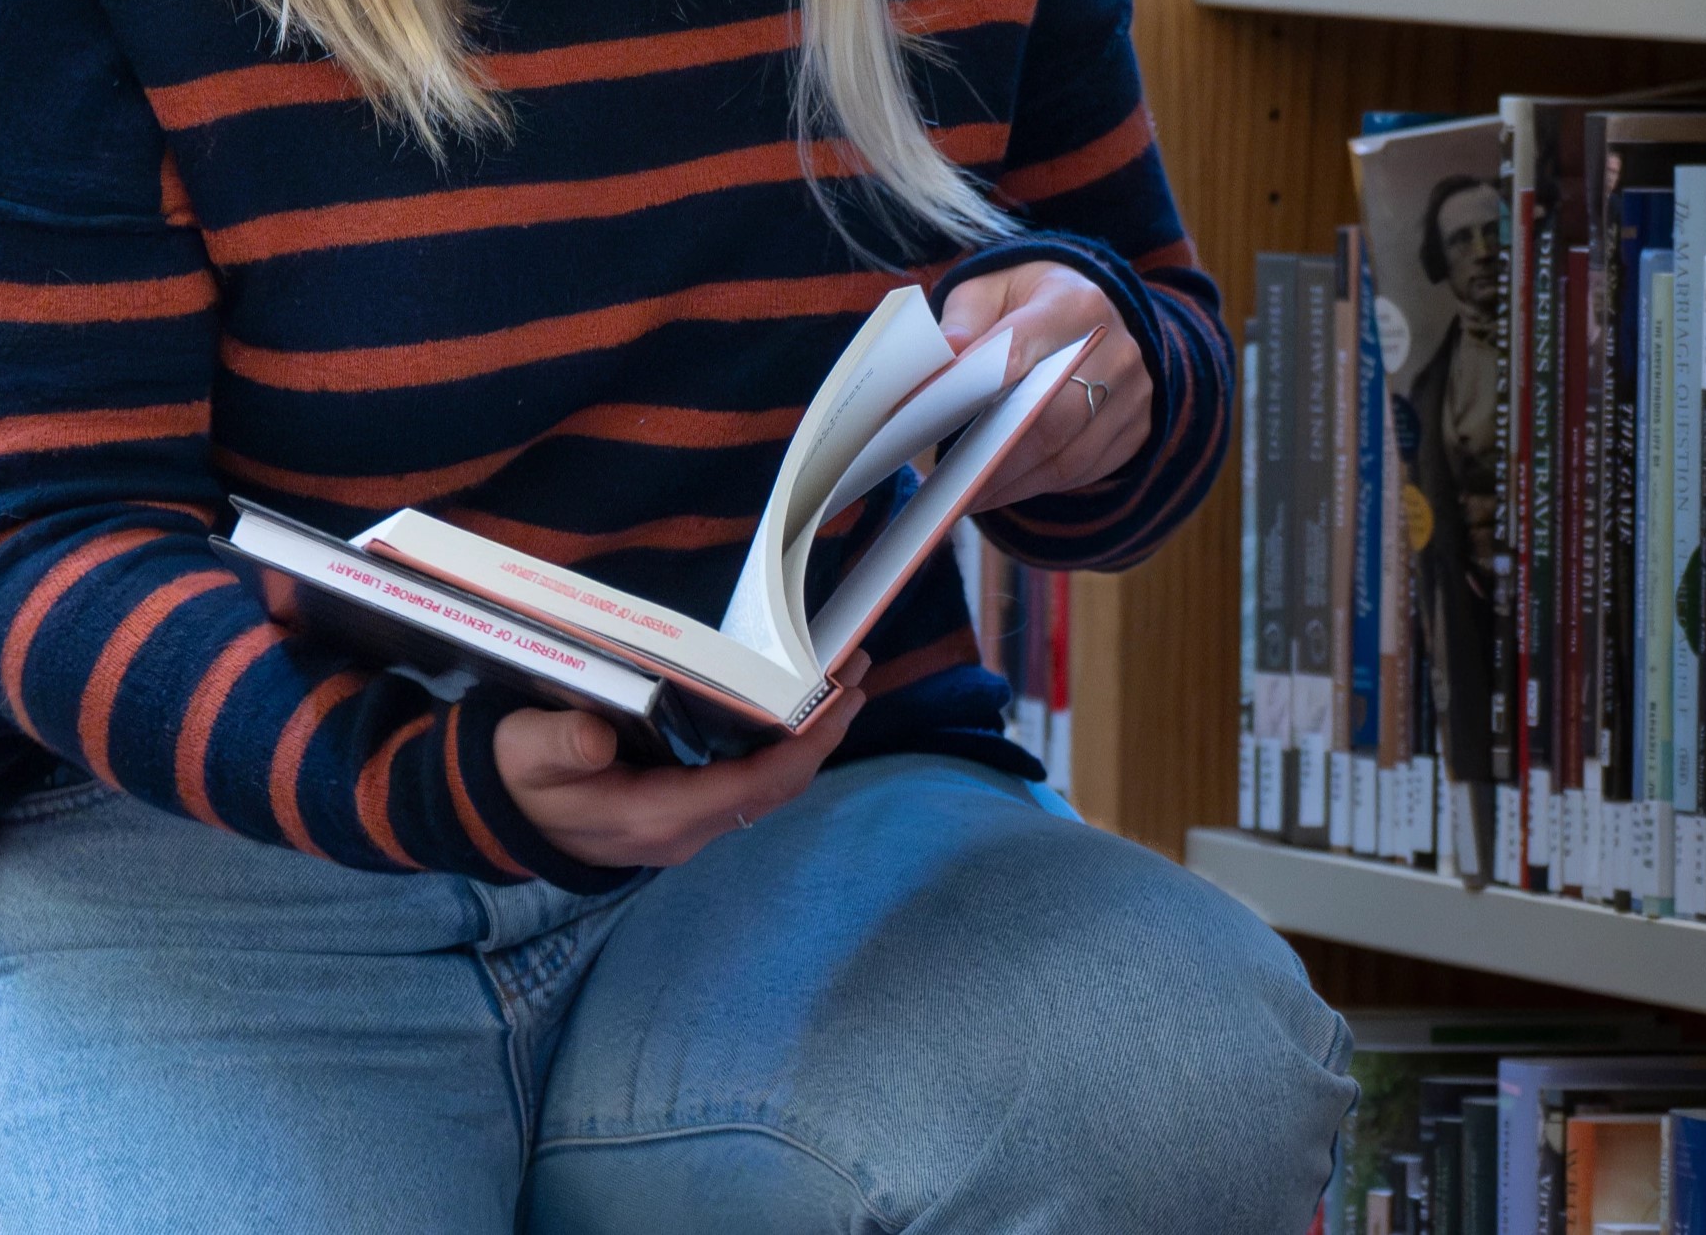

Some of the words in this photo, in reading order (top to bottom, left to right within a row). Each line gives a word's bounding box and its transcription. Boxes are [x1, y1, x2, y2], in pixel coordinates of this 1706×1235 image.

[1535, 232, 1552, 373] DICKENS
[1675, 239, 1691, 373] MARRIAGE
[1674, 380, 1691, 512] QUESTION
[326, 560, 383, 590] LIBRARY
[382, 582, 443, 615] PENROSE
[442, 604, 494, 635] DENVER
[493, 626, 513, 643] OF
[514, 637, 586, 672] UNIVERSITY
